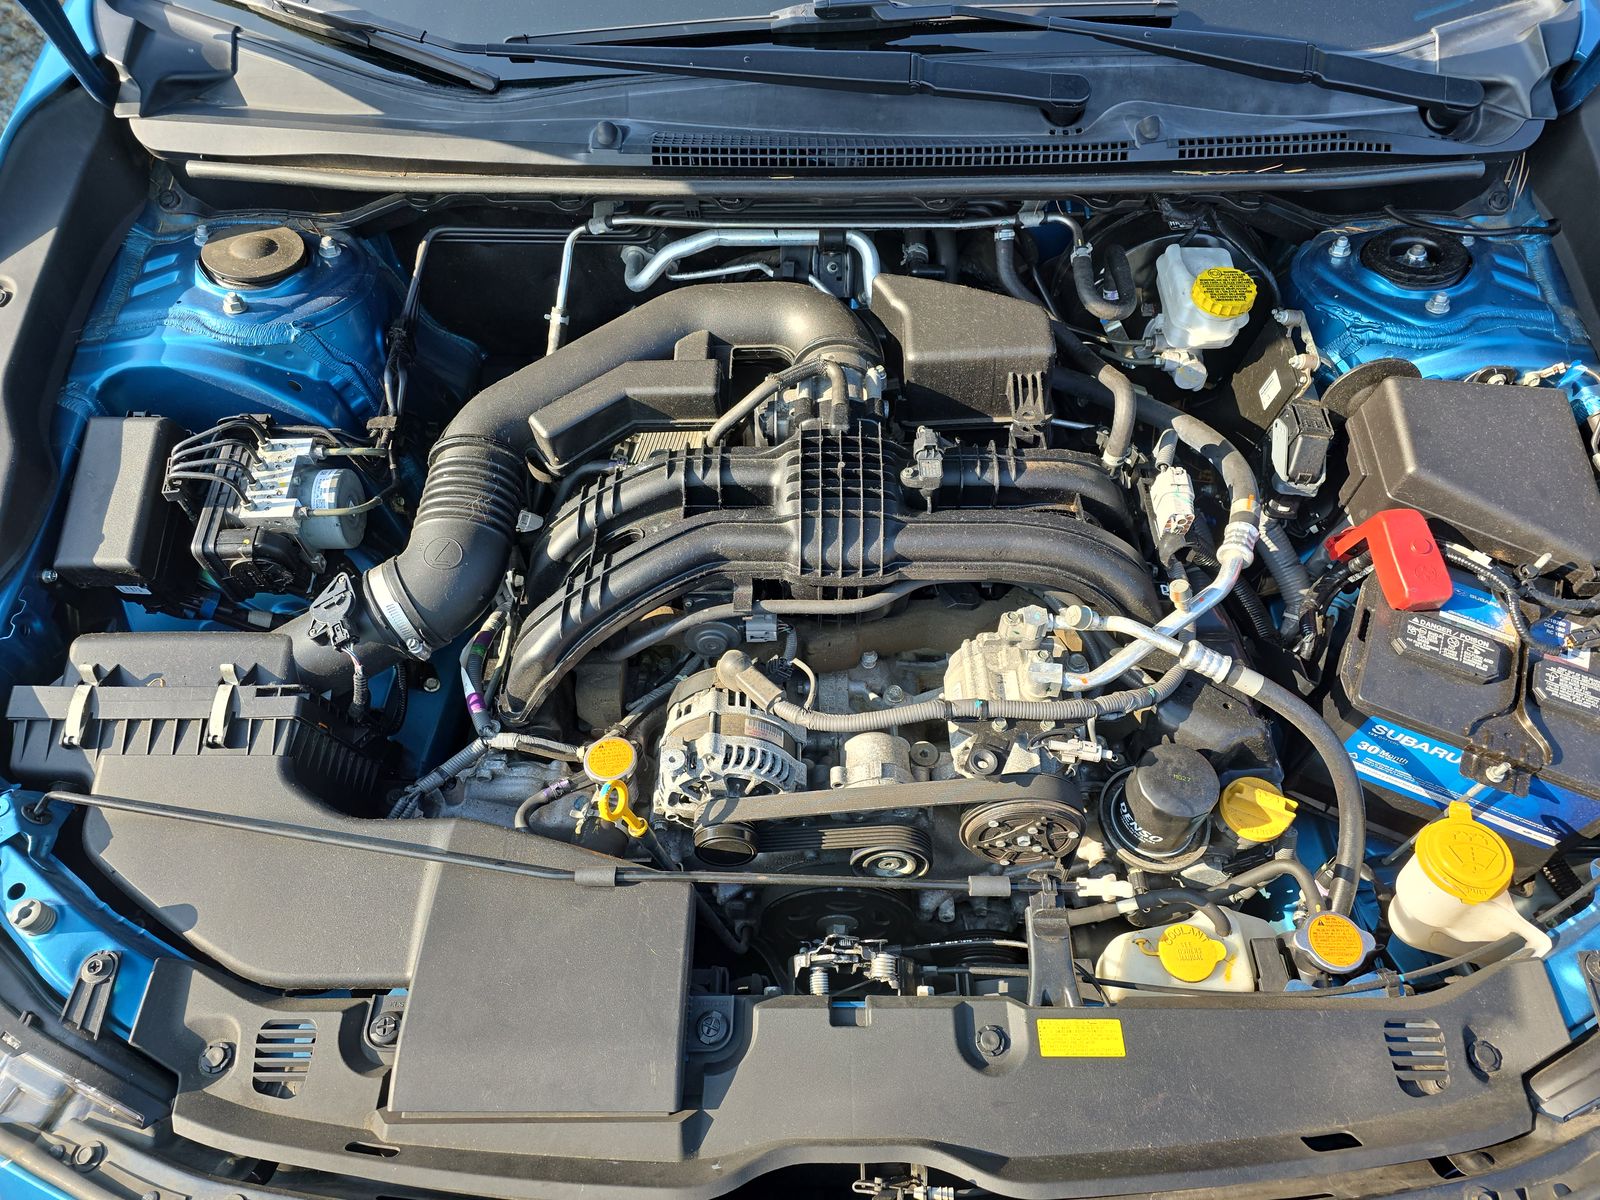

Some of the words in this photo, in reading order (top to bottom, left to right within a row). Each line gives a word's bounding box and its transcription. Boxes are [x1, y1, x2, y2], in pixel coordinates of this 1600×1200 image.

[1420, 619, 1453, 635] DANGER
[1460, 632, 1490, 648] POISON
[1357, 741, 1380, 754] 30
[1379, 749, 1409, 765] Month
[1371, 724, 1462, 764] SUBARU
[1120, 802, 1164, 842] DENSO
[1163, 926, 1209, 946] COOLANT
